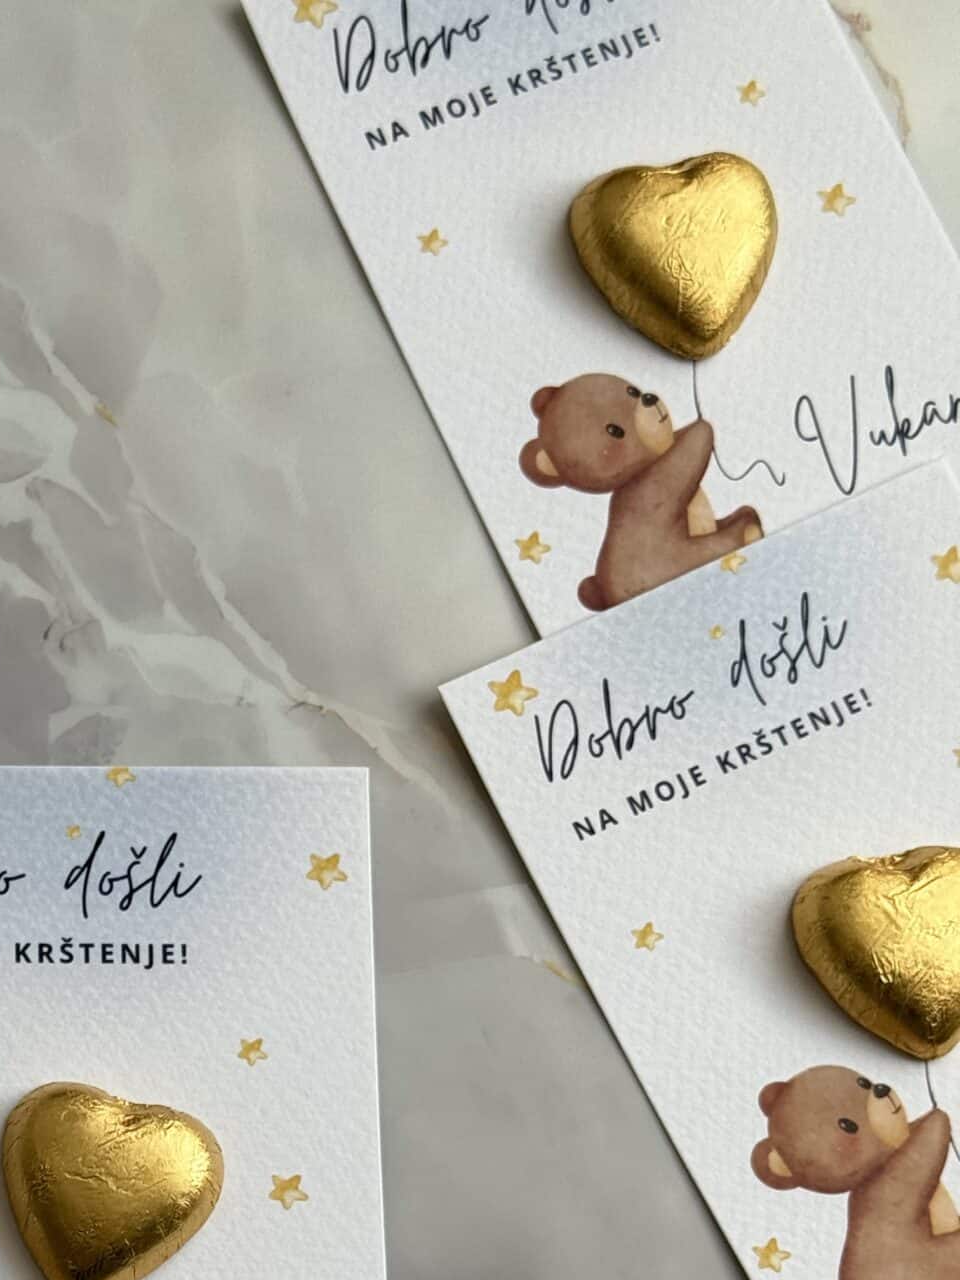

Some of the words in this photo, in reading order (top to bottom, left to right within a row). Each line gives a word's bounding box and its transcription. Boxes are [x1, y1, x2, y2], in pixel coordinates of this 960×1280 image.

[332, 0, 490, 94] Dobro
[364, 120, 410, 151] NA
[418, 84, 498, 130] MOJE
[506, 23, 661, 97] KRŠTENJE!
[533, 677, 695, 783] Dobro
[730, 592, 848, 705] došli
[571, 808, 619, 841] NA
[626, 765, 707, 816] MOJE
[715, 687, 873, 775] KRŠTENJE!
[63, 829, 203, 920] došli
[14, 936, 188, 971] KRŠTENJE!
